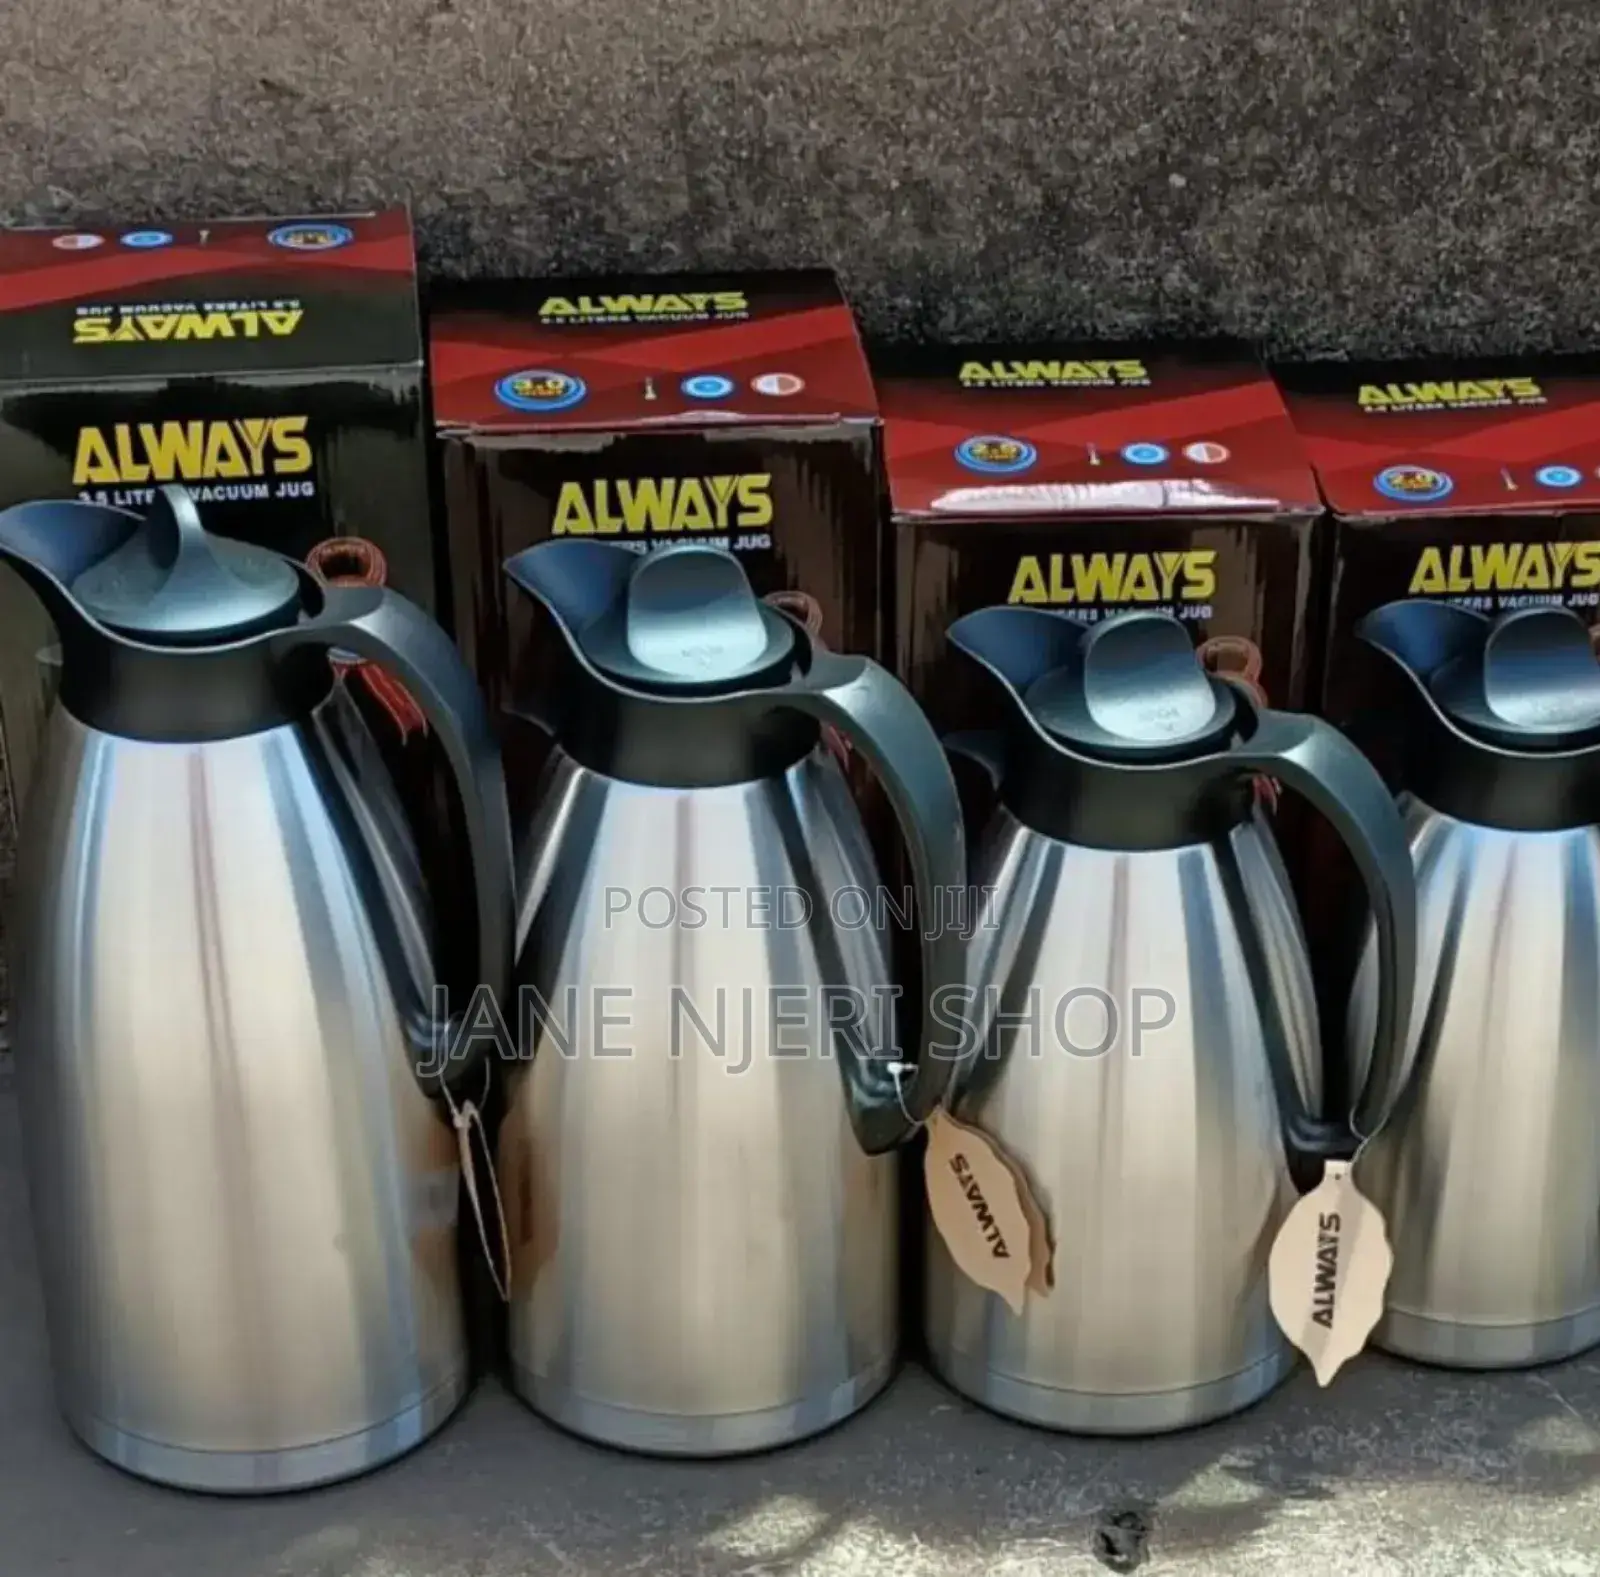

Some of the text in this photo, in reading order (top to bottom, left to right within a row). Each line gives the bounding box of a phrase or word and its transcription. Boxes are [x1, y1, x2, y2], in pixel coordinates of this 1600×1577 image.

[538, 292, 748, 316] ALWAYS
[73, 310, 303, 343] ALWAYS
[959, 360, 1148, 380] ALWAYS
[1358, 377, 1543, 405] ALWAYS
[73, 416, 313, 485] ALWAYS
[188, 484, 269, 502] VACUUM
[275, 481, 315, 497] JUG
[551, 473, 773, 535] ALWAYS
[733, 534, 772, 549] JUG
[1007, 549, 1218, 604] ALWAYS
[1407, 540, 1600, 595] ALWAYS
[1179, 604, 1213, 619] JUG
[949, 1152, 1011, 1259] ALWAYS
[1311, 1211, 1341, 1329] ALWAYS
